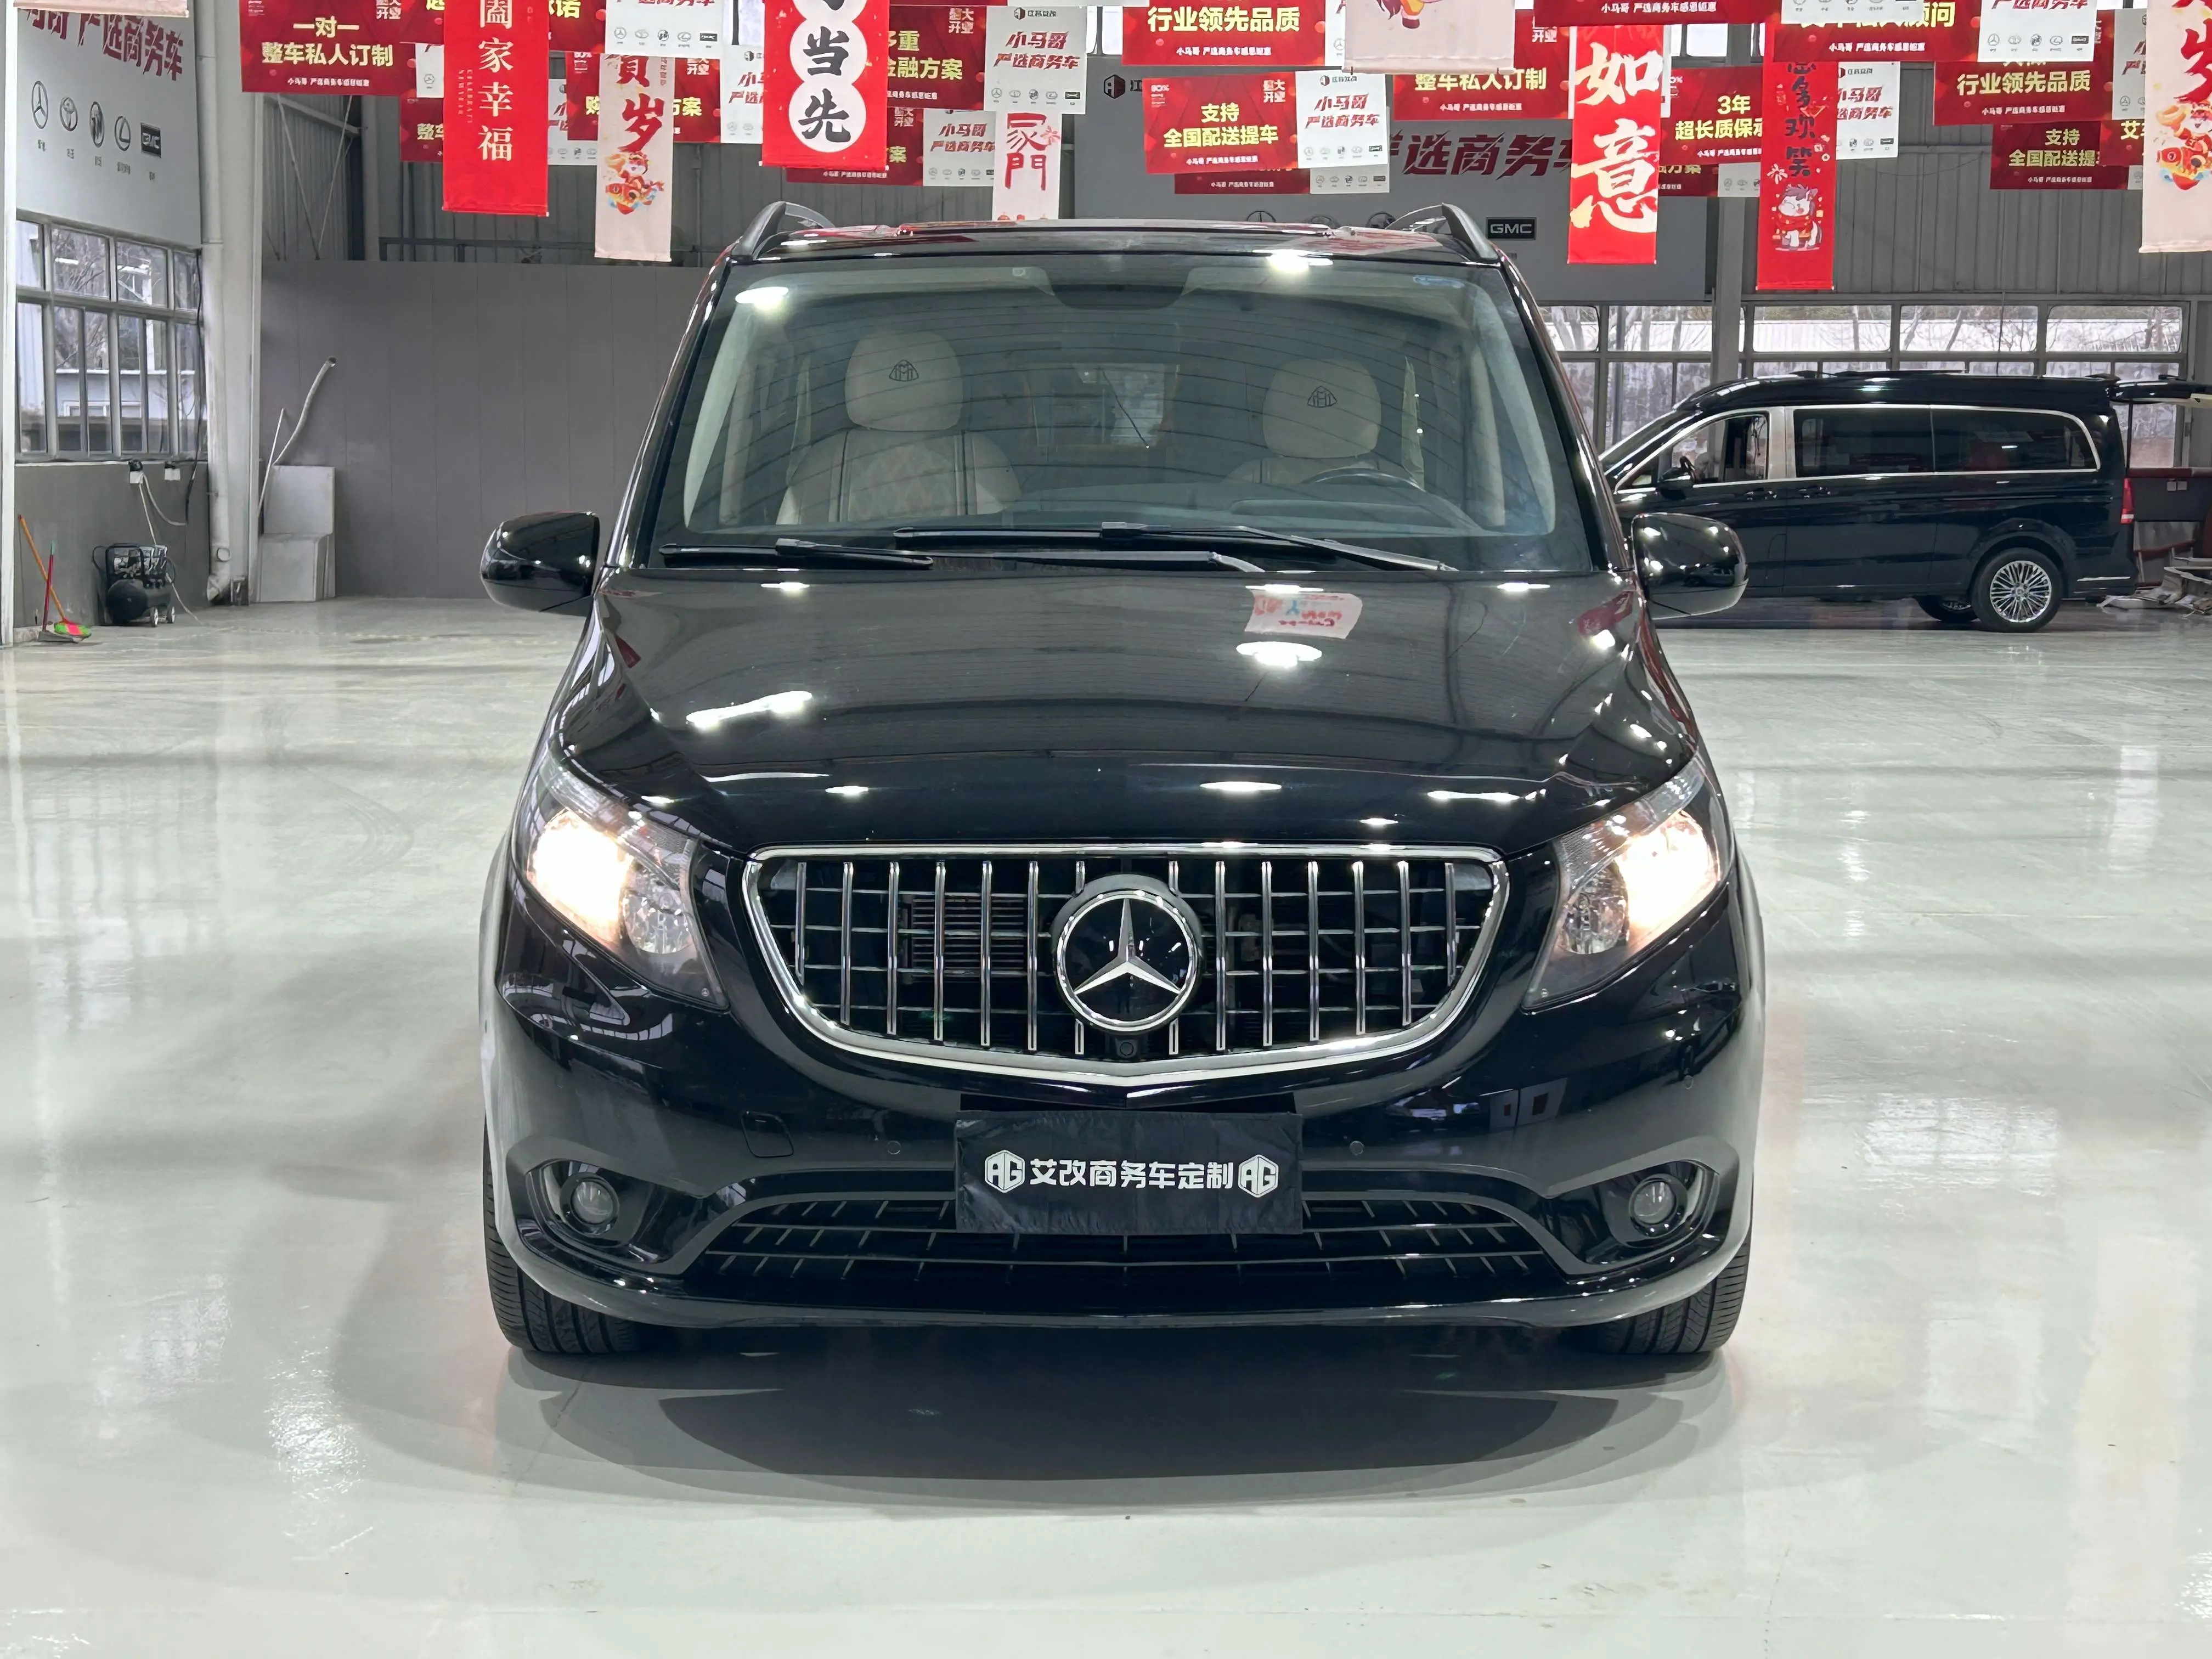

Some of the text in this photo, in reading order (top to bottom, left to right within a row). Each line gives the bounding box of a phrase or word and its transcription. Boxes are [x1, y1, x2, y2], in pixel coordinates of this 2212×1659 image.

[293, 16, 359, 38] 一对一
[1148, 7, 1300, 32] 行业领先品质
[1005, 31, 1069, 49] 小马哥
[261, 42, 393, 67] 整车私人订制
[993, 53, 1080, 70] 严选商务车
[798, 0, 851, 143] 当先
[1414, 68, 1547, 92] 整车私人订制
[1957, 70, 2091, 96] 行业领先品质
[729, 91, 764, 104] 严选
[1717, 94, 1751, 115] 3年
[1201, 102, 1240, 123] 支持
[1163, 124, 1279, 148] 全国配送提车
[1570, 42, 1664, 235] 如意
[2045, 128, 2080, 146] 支持
[2121, 120, 2145, 140] 艾
[2008, 149, 2100, 167] 全国配送提
[1489, 223, 1532, 234] GMC
[985, 1150, 1279, 1198] AG 艾改商务车定制 AG
